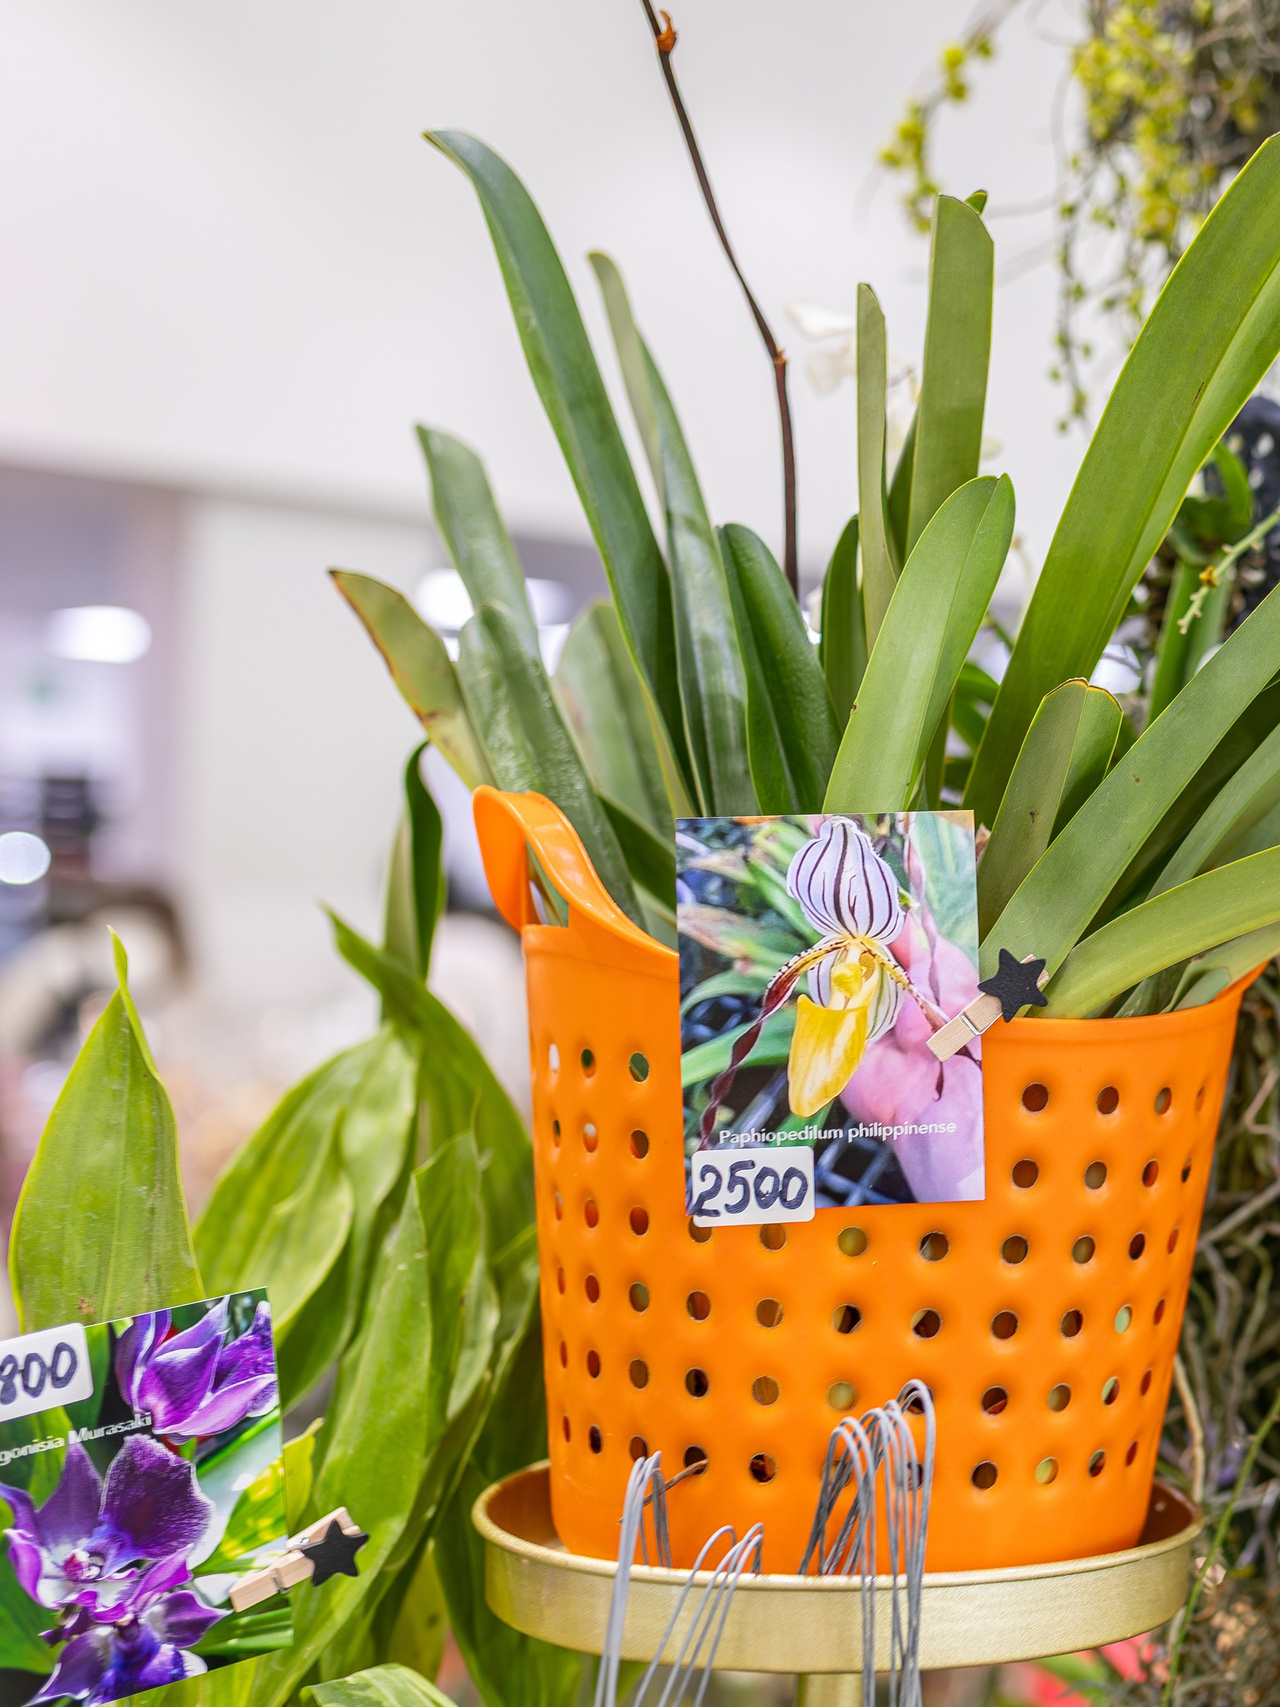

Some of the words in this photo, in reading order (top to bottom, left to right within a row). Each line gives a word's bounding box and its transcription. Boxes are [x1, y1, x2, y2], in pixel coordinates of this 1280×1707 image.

[719, 1125, 843, 1148] Paphiopedilum
[848, 1121, 957, 1143] philippinense
[690, 1160, 808, 1217] 2500
[68, 1412, 152, 1444] Murasaki
